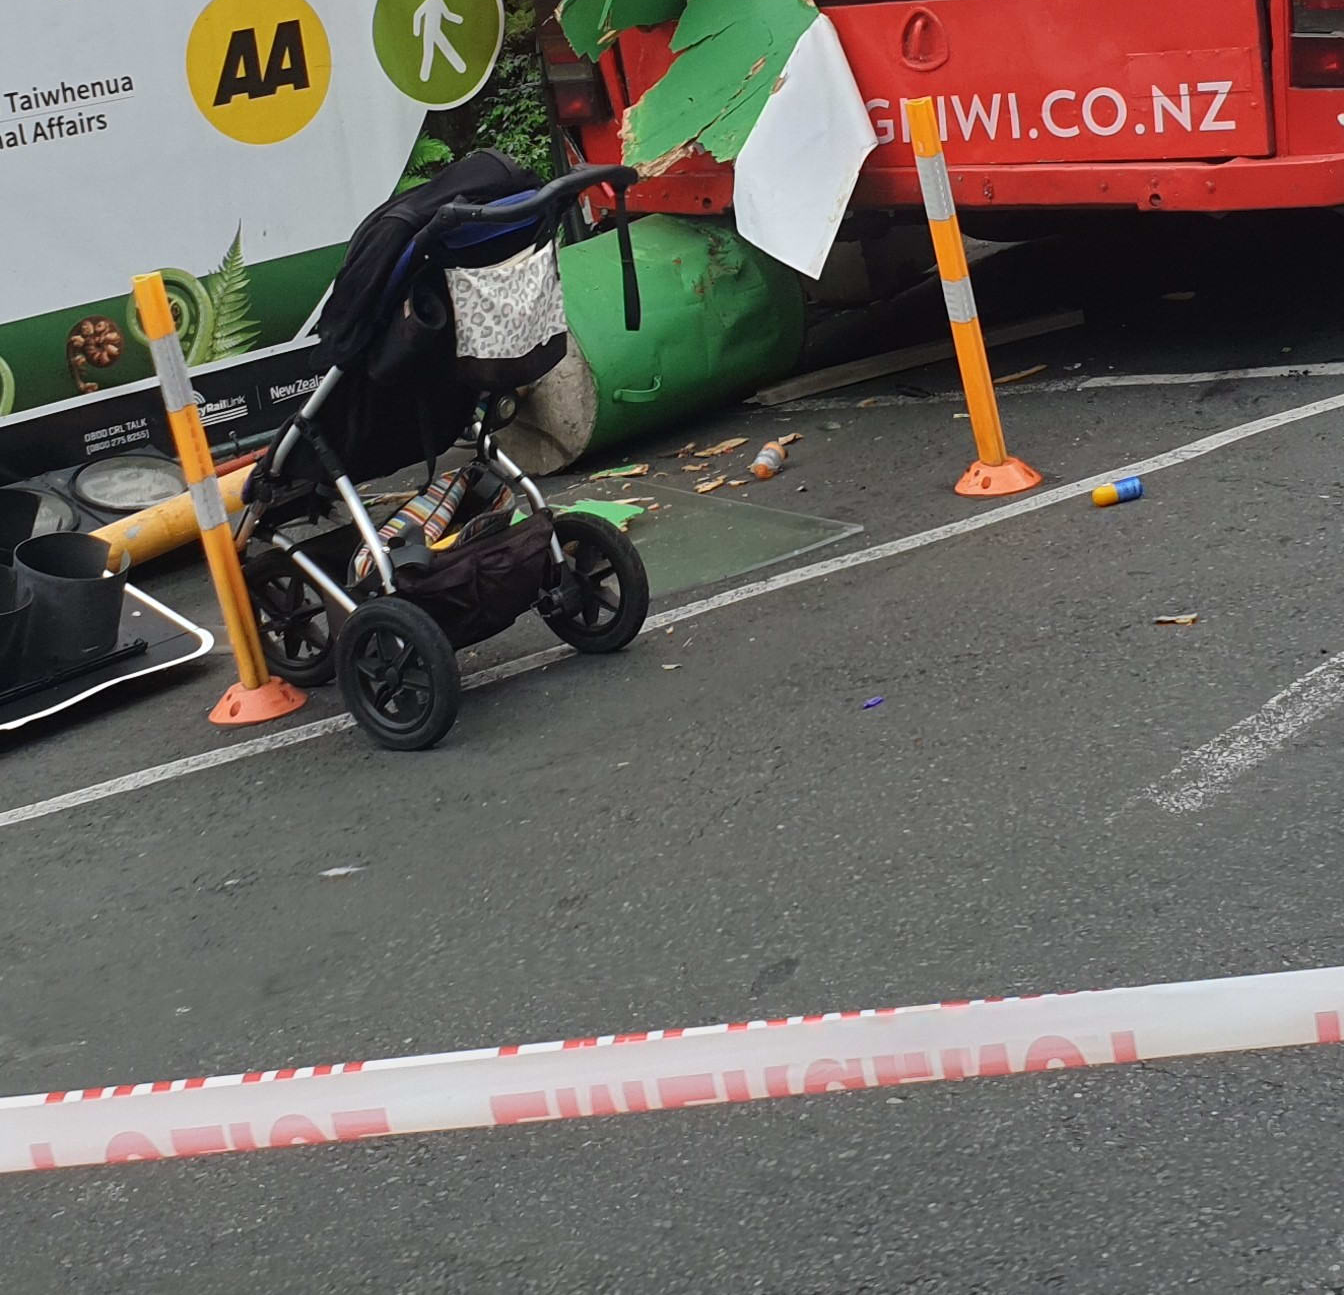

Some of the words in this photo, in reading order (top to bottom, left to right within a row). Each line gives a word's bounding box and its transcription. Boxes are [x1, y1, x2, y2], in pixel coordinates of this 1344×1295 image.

[212, 19, 311, 107] AA
[4, 73, 135, 113] Taiwhenua
[32, 108, 108, 144] Affairs
[269, 384, 295, 400] New
[295, 375, 326, 392] Zeala
[84, 430, 109, 443] 0800
[108, 426, 126, 439] CRL
[126, 418, 148, 432] TALK
[111, 436, 127, 449] 275
